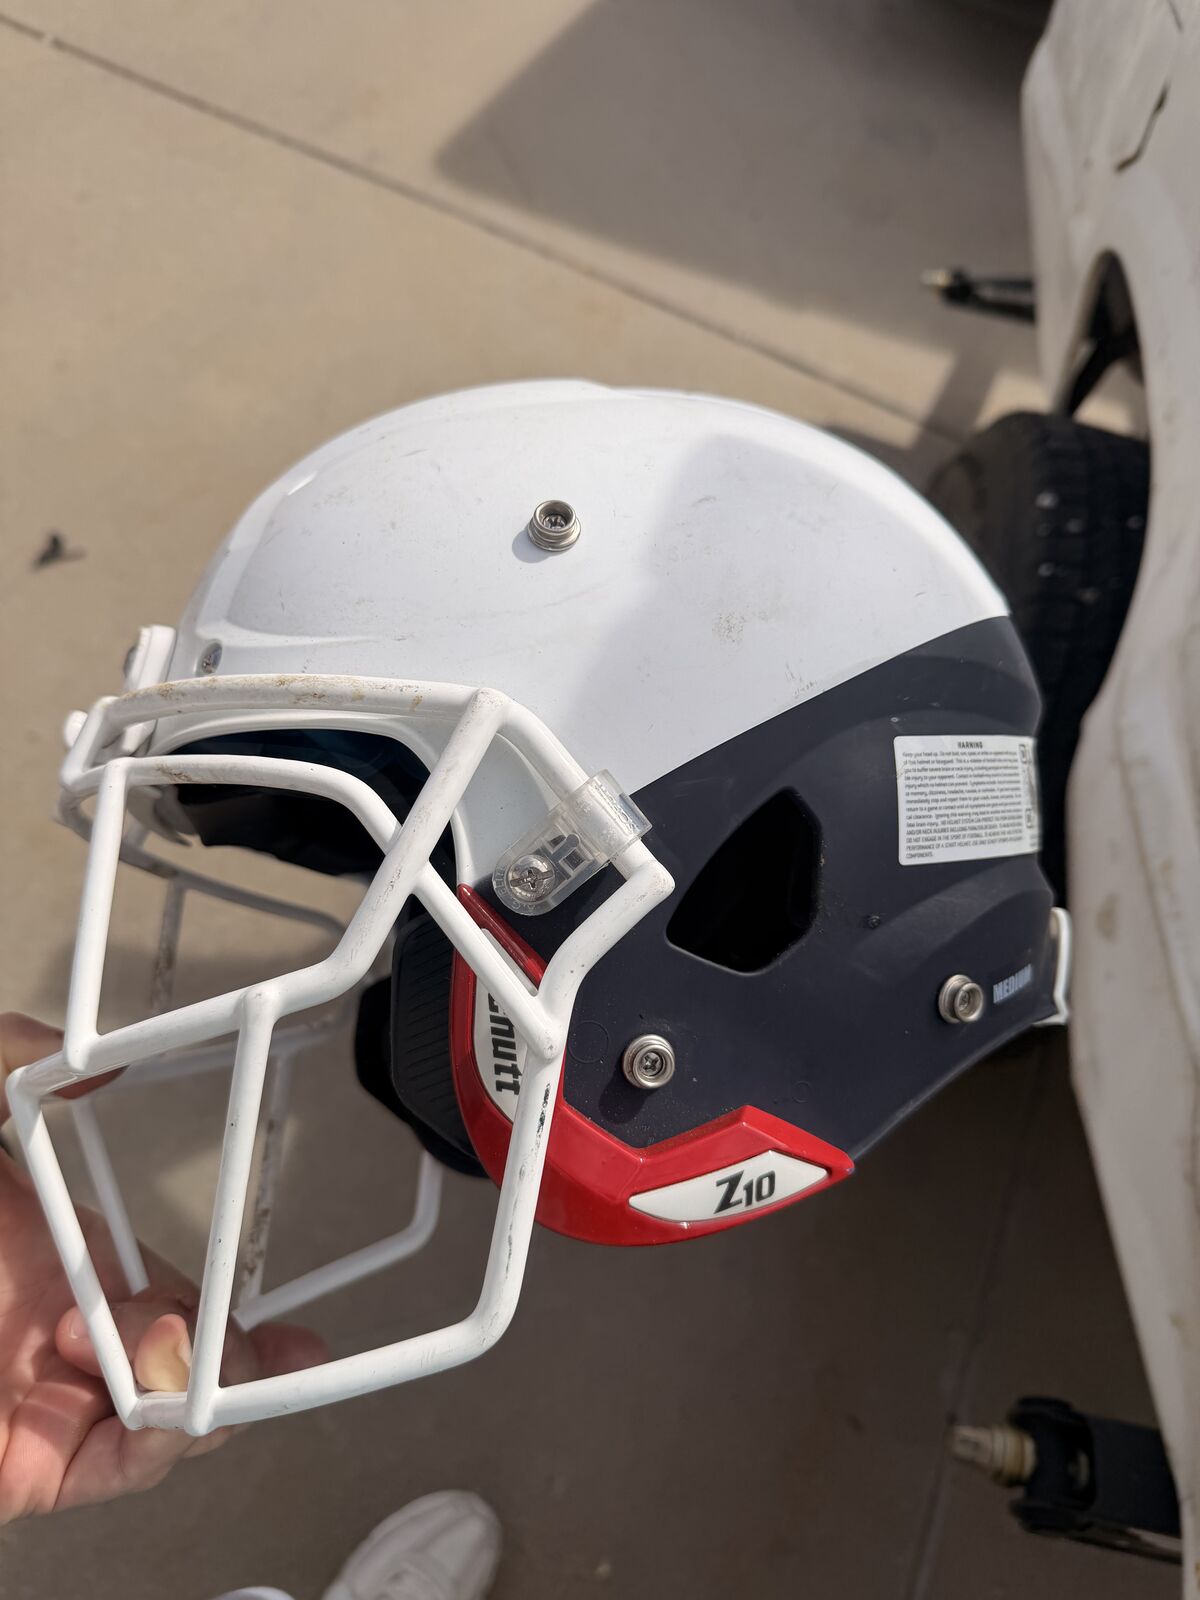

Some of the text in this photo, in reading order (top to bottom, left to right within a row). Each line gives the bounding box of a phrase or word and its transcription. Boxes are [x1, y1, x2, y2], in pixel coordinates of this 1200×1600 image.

[957, 741, 983, 749] WARNING
[993, 963, 1032, 1004] MEDIUM
[713, 1169, 776, 1214] Z10
